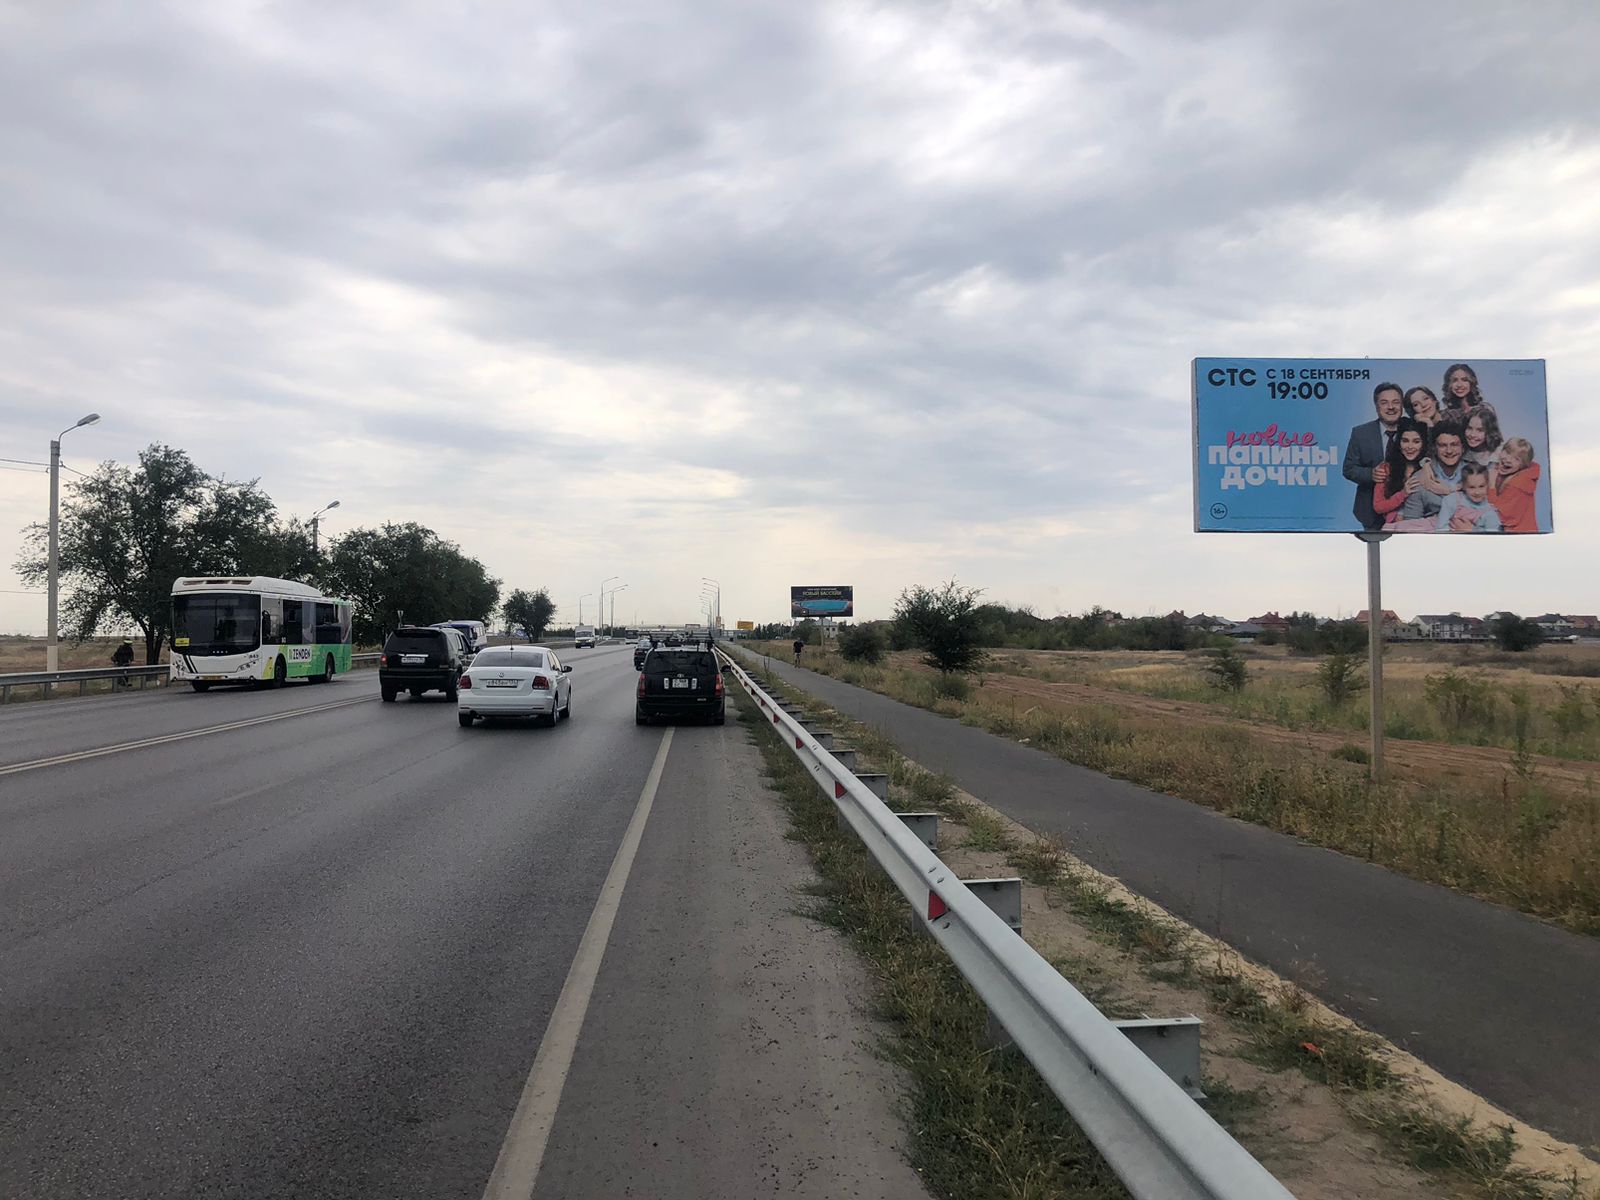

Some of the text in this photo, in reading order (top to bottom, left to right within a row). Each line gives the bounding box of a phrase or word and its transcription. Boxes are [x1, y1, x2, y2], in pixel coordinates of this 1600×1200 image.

[1208, 368, 1256, 386] СТС
[1266, 369, 1370, 380] С 18 СЕНТЯБРЯ
[1267, 382, 1328, 400] 19:00
[292, 648, 311, 660] ZENDEN
